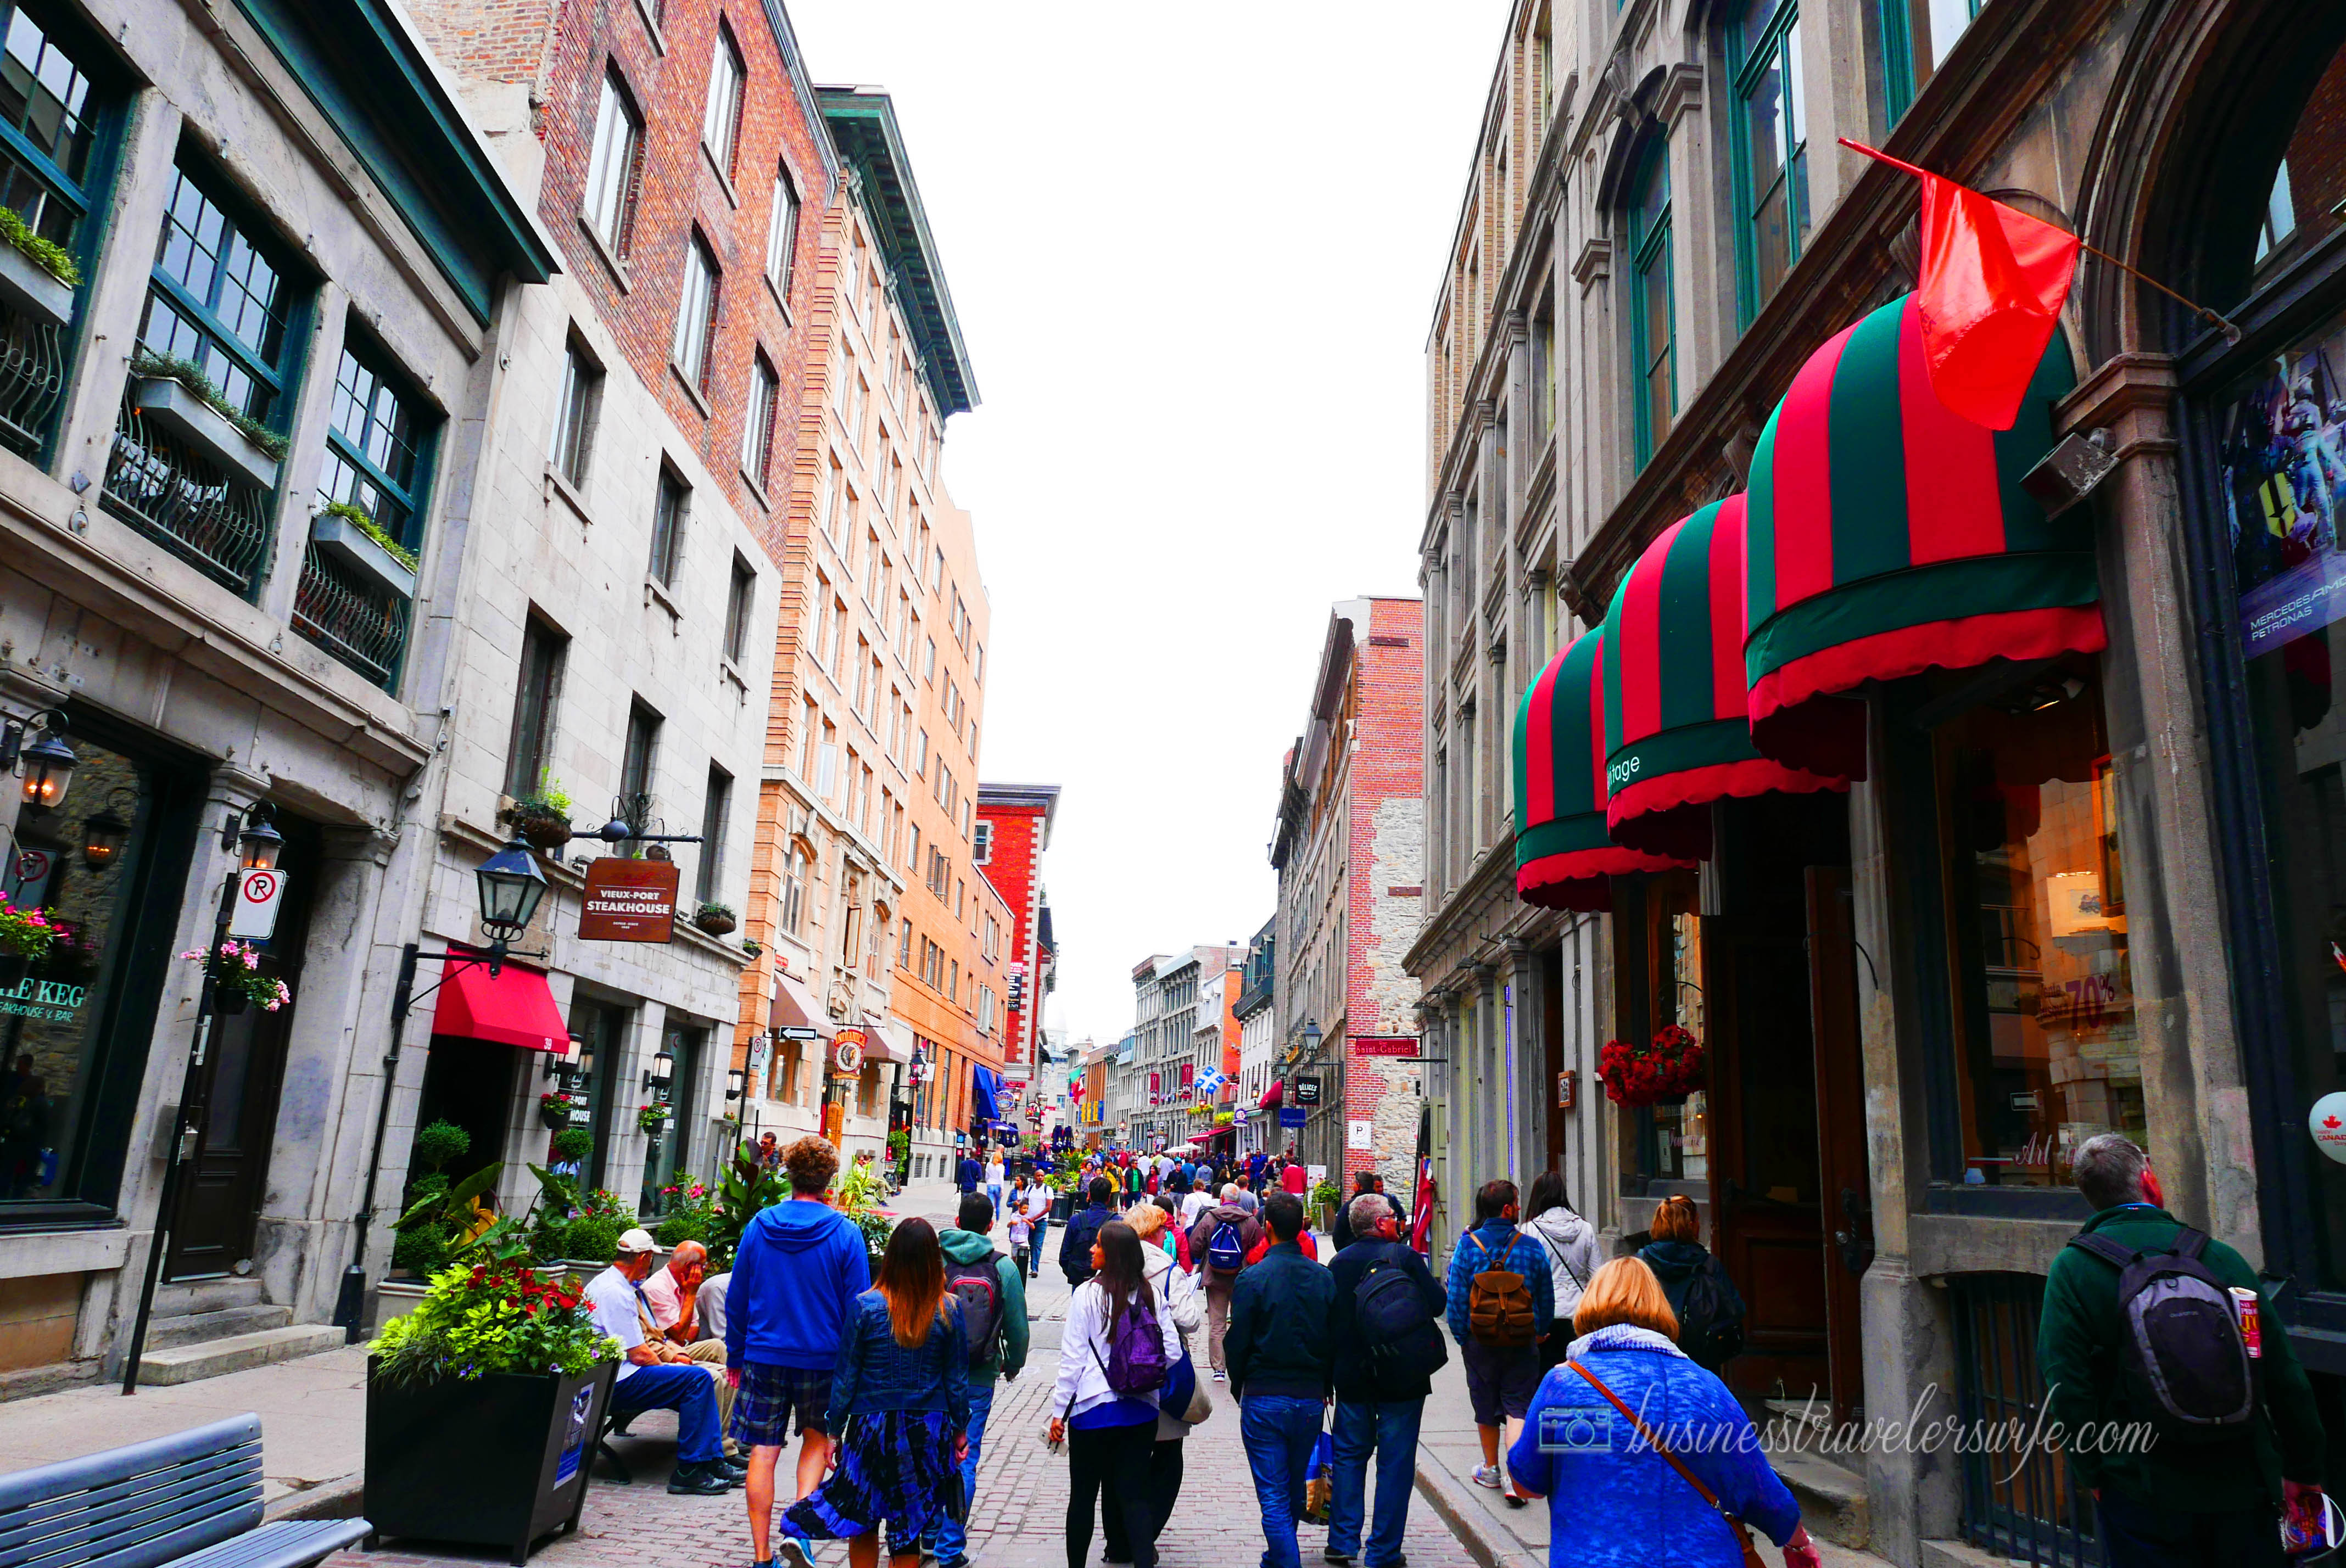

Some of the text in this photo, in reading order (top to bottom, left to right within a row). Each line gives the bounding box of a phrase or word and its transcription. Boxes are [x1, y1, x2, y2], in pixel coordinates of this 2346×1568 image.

[2250, 595, 2310, 630] MERCEDES
[2252, 606, 2313, 641] PETRONAS
[600, 889, 660, 900] VIEUX-PORT
[586, 900, 671, 914] STEAKHOUSE
[35, 980, 85, 1008] KEG
[54, 1010, 74, 1023] BAR
[544, 1038, 552, 1050] 39
[1356, 1045, 1411, 1054] Saint-Gabriel
[1298, 1083, 1317, 1092] DÉLICES
[569, 1109, 591, 1123] HOUSE
